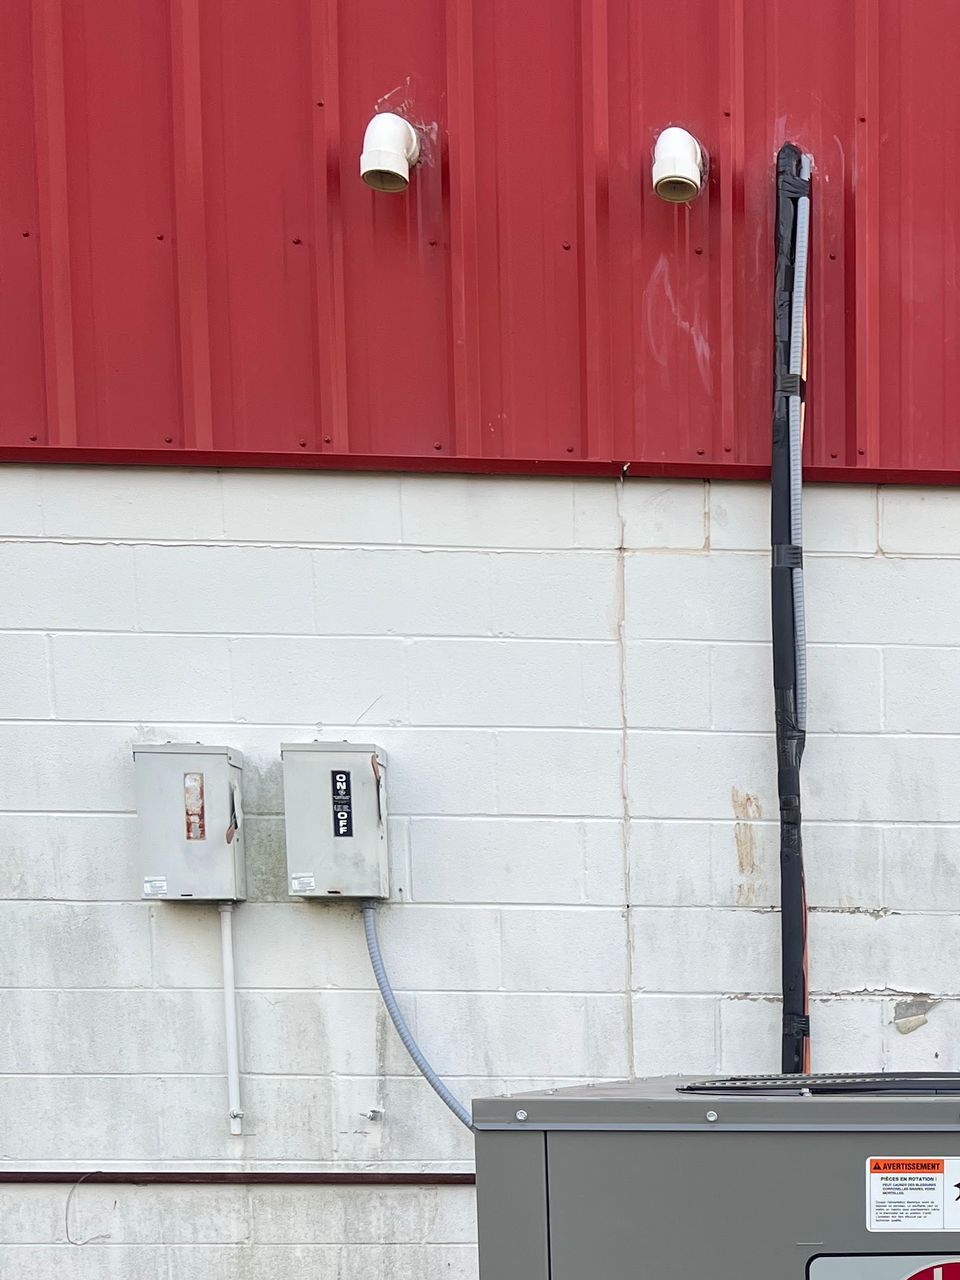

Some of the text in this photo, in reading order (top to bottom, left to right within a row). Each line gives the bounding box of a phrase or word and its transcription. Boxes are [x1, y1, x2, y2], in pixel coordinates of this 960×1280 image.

[336, 774, 346, 790] ON
[337, 812, 348, 834] OFF
[883, 1163, 940, 1171] AVERTISSEMENT
